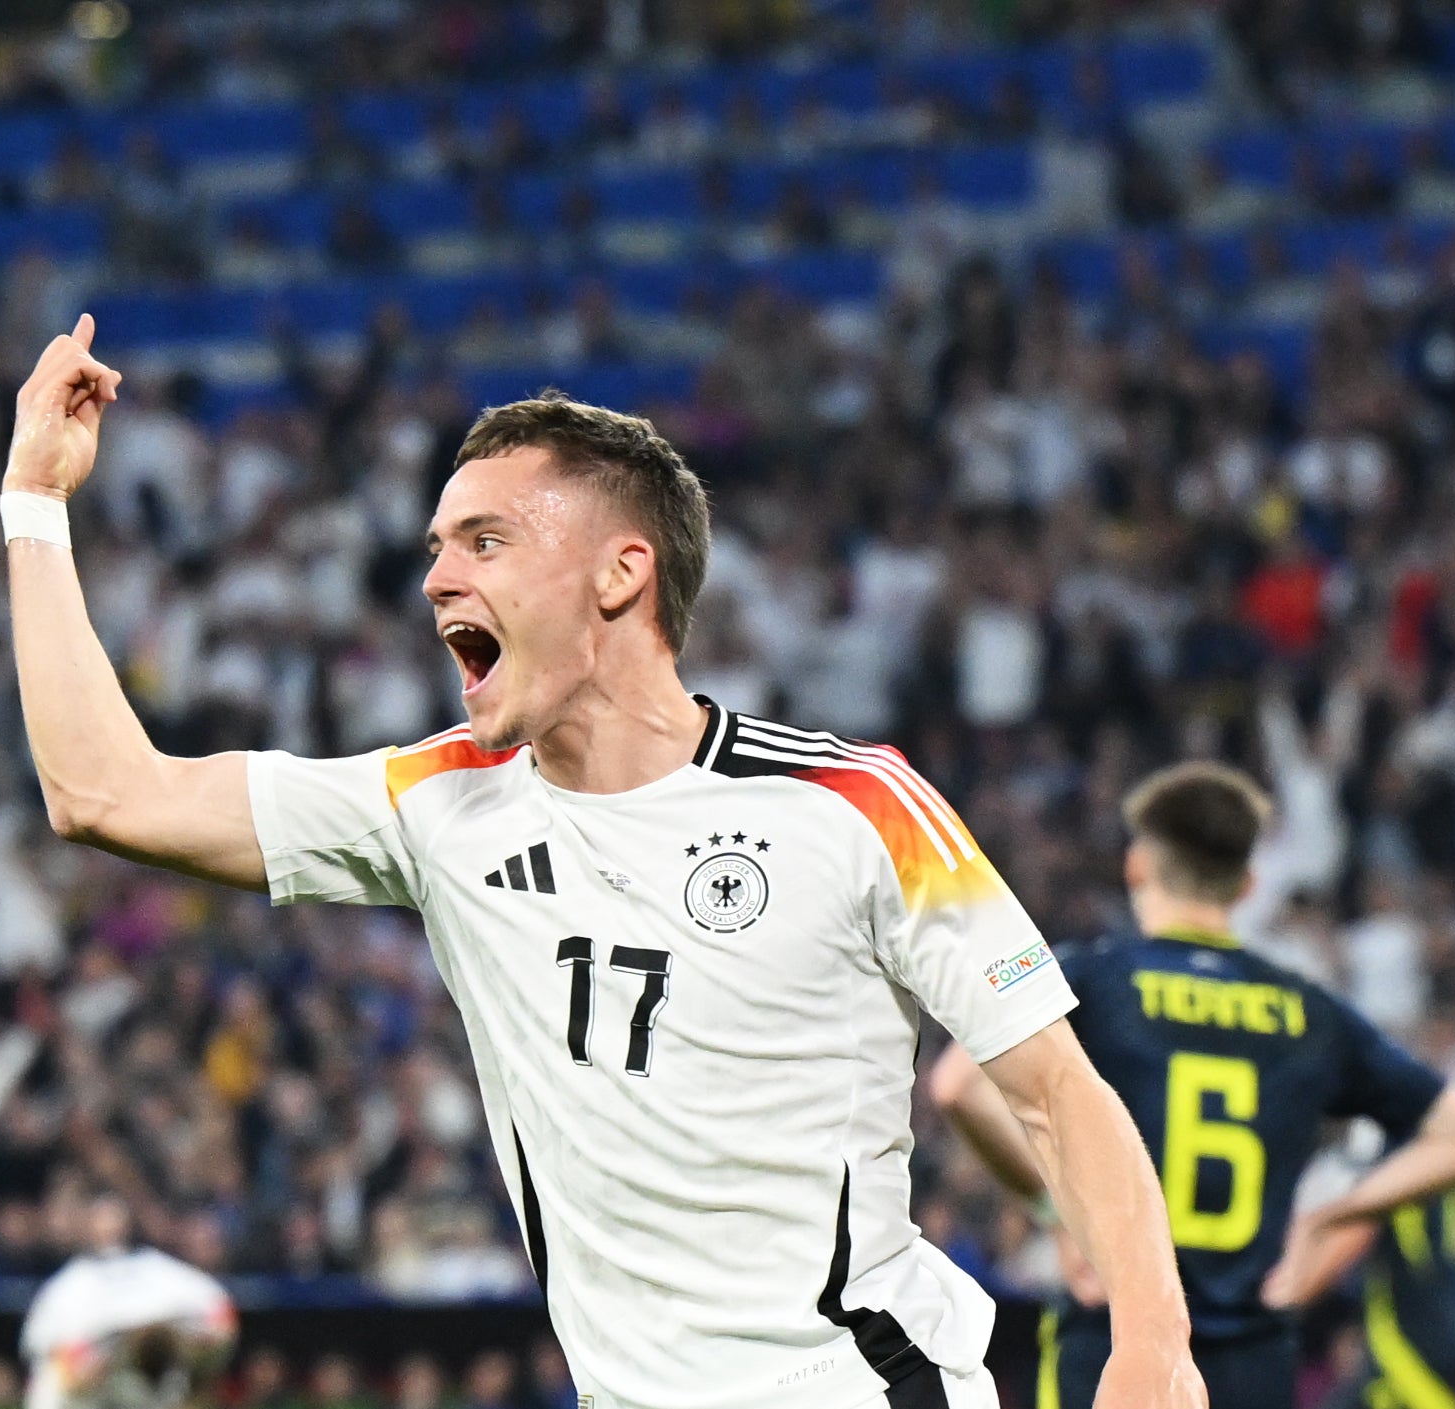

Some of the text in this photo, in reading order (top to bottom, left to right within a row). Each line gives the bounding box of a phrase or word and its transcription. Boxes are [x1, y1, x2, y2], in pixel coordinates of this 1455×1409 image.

[702, 862, 750, 879] DEUTSCHER
[983, 957, 1007, 977] UEFA
[988, 943, 1050, 989] FOUNDA
[556, 936, 674, 1078] 17
[1162, 1050, 1268, 1254] 6
